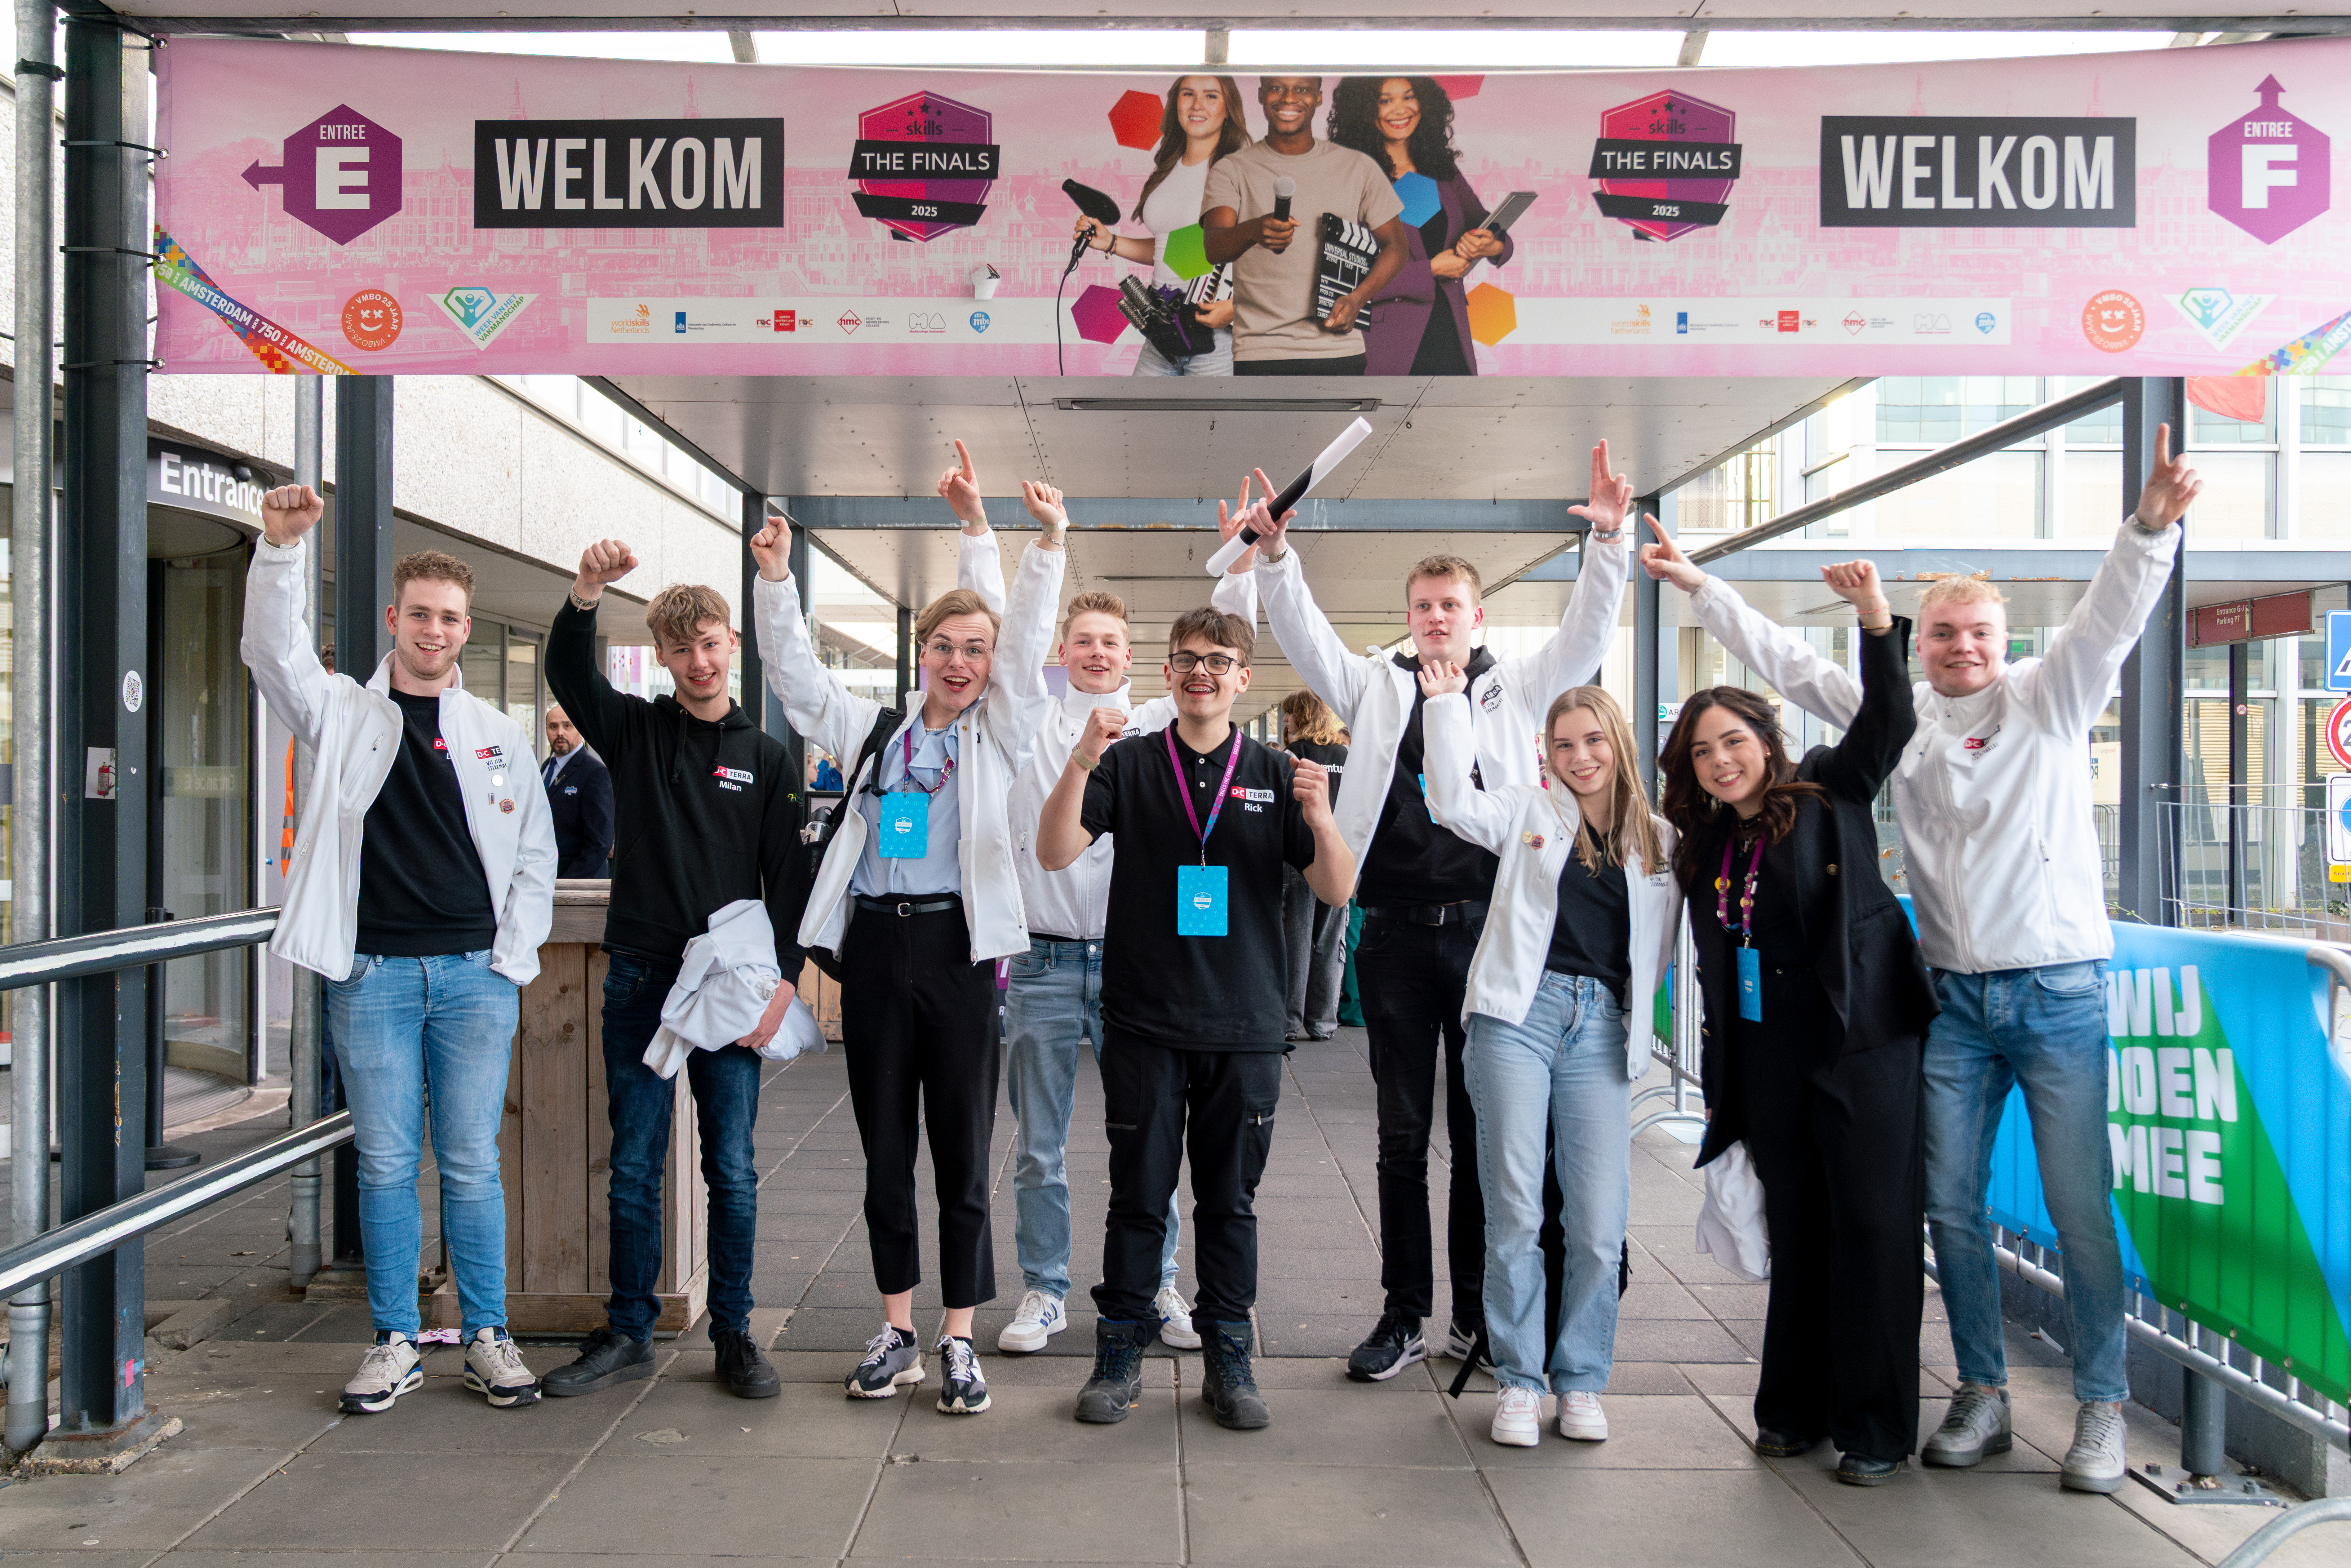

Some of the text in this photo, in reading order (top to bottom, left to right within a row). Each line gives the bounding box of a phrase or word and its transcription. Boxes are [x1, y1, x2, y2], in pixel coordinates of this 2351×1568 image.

[320, 124, 366, 140] ENTREE
[906, 120, 944, 136] skills
[1649, 119, 1686, 134] skills
[2244, 121, 2293, 137] ENTREE
[861, 152, 990, 170] THE FINALS
[1601, 151, 1733, 170] THE FINALS
[316, 147, 370, 210] E
[495, 137, 762, 210] WELKOM
[1841, 135, 2114, 210] WELKOM
[2242, 145, 2298, 209] F
[911, 205, 937, 217] 2025
[1652, 205, 1680, 217] 2025
[1325, 243, 1347, 259] UNIVERSAL
[1326, 255, 1338, 264] SCENE
[179, 277, 253, 326] AMSTERDAM
[257, 321, 281, 342] 750
[355, 293, 398, 330] VMBO 25 JAAR
[474, 293, 518, 337] WEEK VAN HET
[2095, 293, 2141, 332] VMBO 25 JAAR
[478, 296, 524, 342] VAKMANSCHAP
[2217, 296, 2262, 343] VAKMANSCHAP
[161, 452, 264, 518] Entrance
[2217, 607, 2236, 616] Entrance
[2217, 617, 2234, 625] Parking
[1483, 686, 1500, 700] TERRA
[729, 771, 751, 781] TERRA
[719, 780, 741, 791] Milan
[1249, 791, 1273, 800] TERRA
[1245, 803, 1263, 812] Rick
[2107, 965, 2202, 1037] WIJ
[2108, 1123, 2224, 1205] MEE
